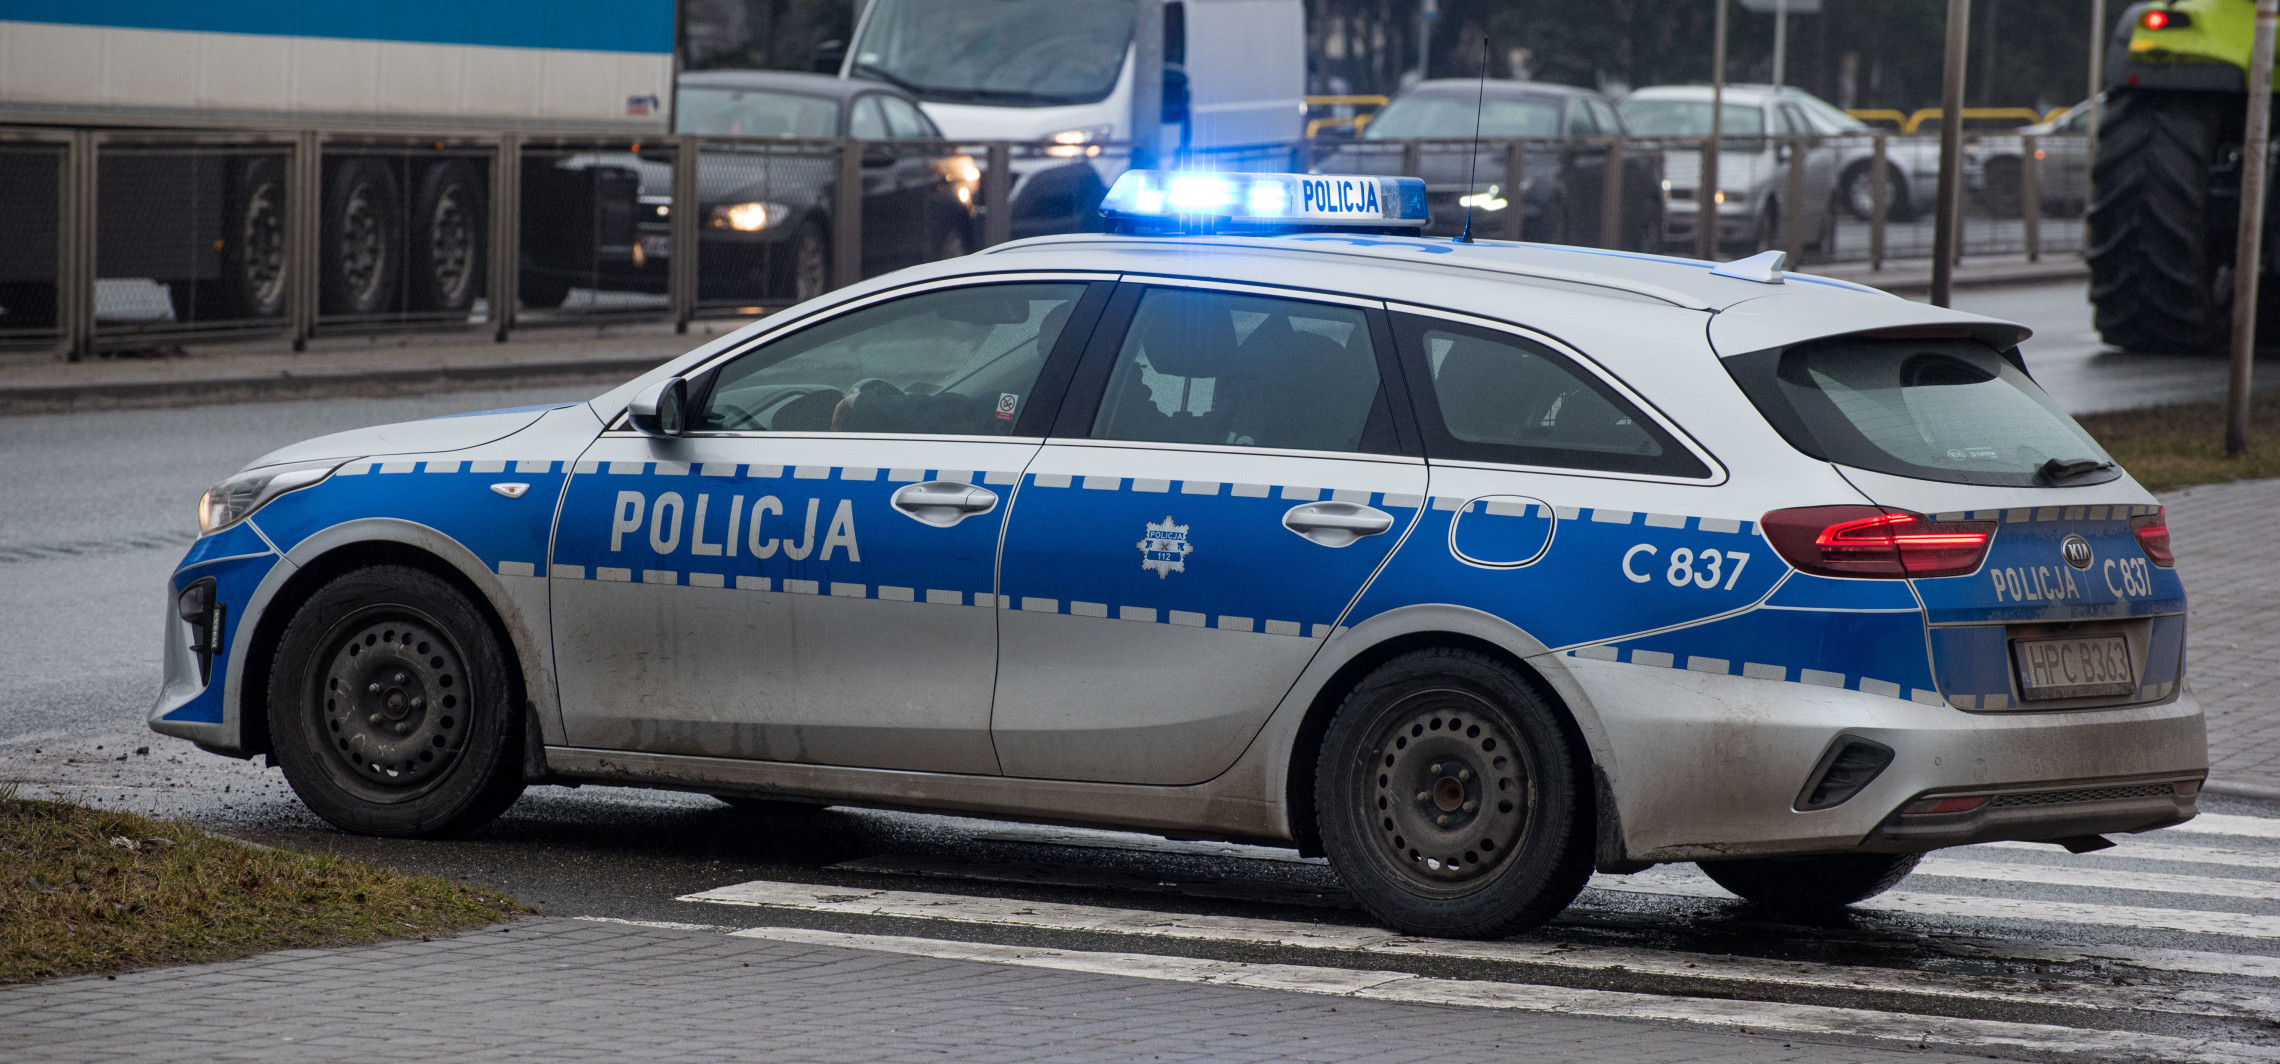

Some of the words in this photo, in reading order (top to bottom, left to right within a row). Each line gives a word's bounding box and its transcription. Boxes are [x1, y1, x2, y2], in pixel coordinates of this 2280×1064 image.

[1302, 180, 1379, 213] POLICJA
[610, 490, 861, 563] POLICJA
[1150, 531, 1183, 540] POLICJA
[1157, 552, 1171, 561] 112
[1622, 543, 1658, 583] C
[1666, 547, 1750, 591] 837
[2067, 543, 2090, 561] KIA
[1990, 565, 2080, 602] POLICJA
[2104, 558, 2124, 598] C
[2120, 557, 2152, 597] 837
[2029, 643, 2077, 685] HPC
[2079, 641, 2128, 683] B363
